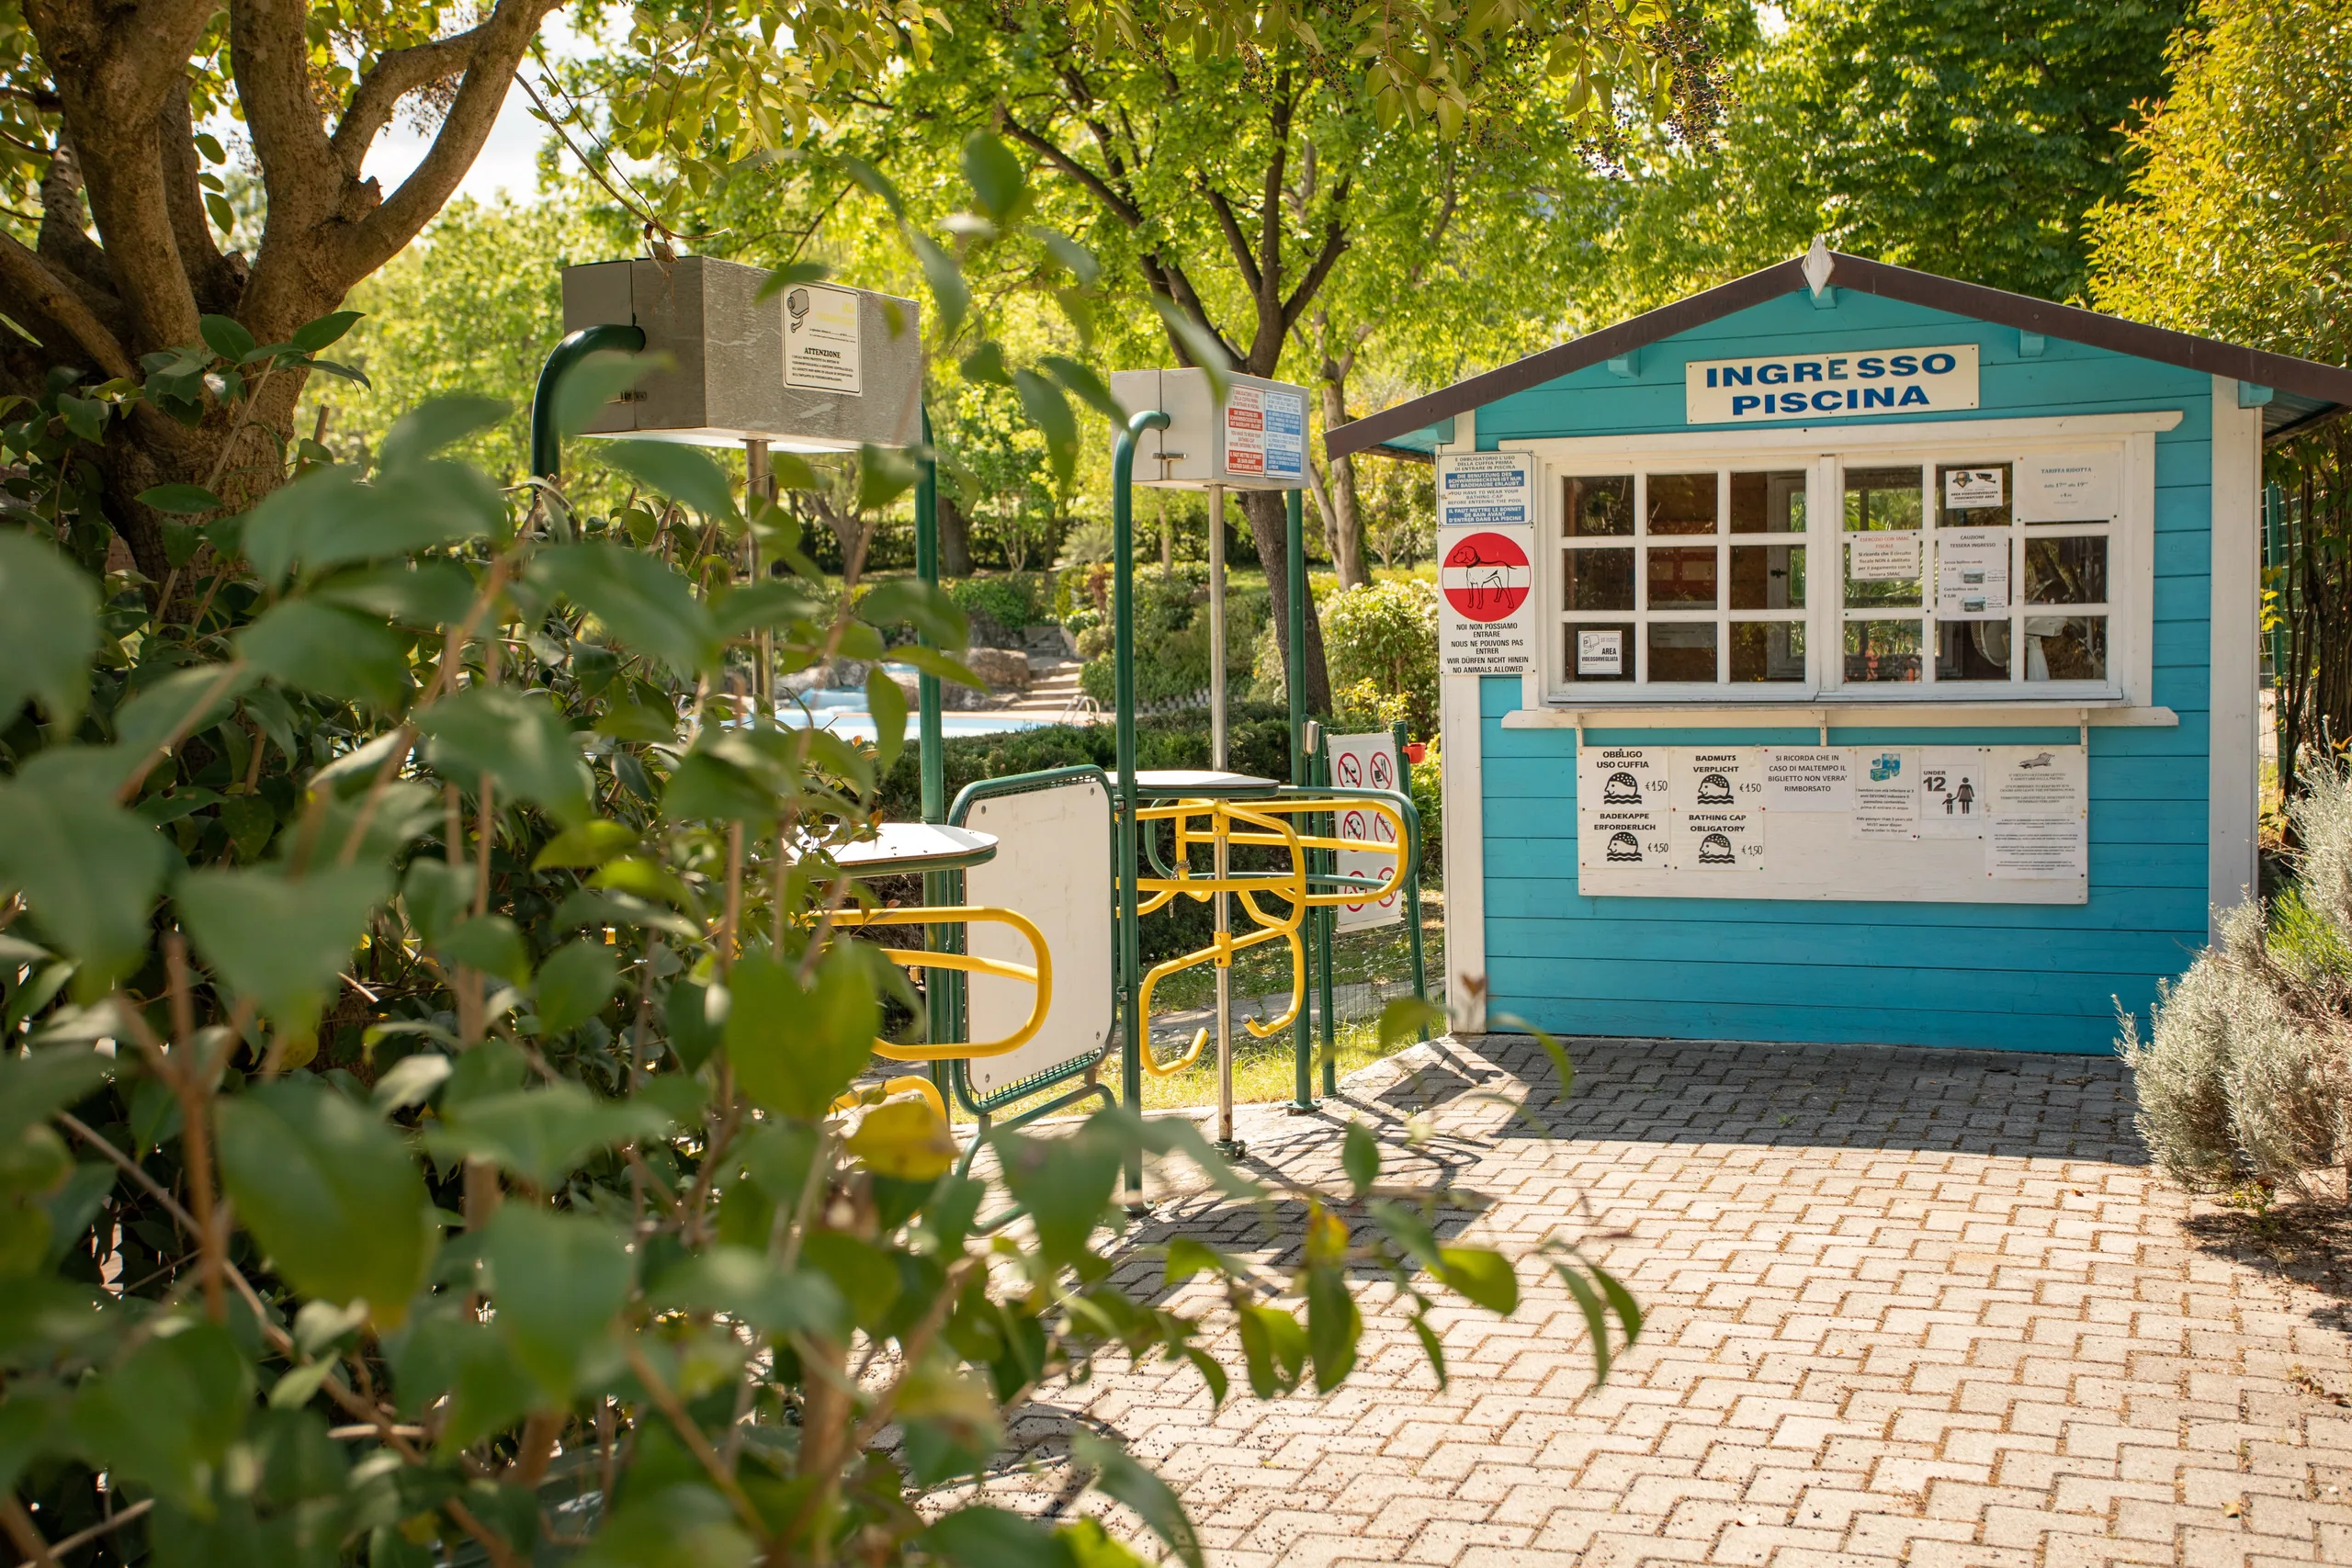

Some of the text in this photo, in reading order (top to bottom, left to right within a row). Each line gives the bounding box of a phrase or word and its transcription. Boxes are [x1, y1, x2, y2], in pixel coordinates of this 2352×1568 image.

[804, 347, 841, 358] ATTENZIONE
[1706, 353, 1956, 388] INGRESSO
[1732, 385, 1930, 415] PISCINA
[1602, 750, 1642, 759] OBBLIGO
[1923, 777, 1946, 792] 12
